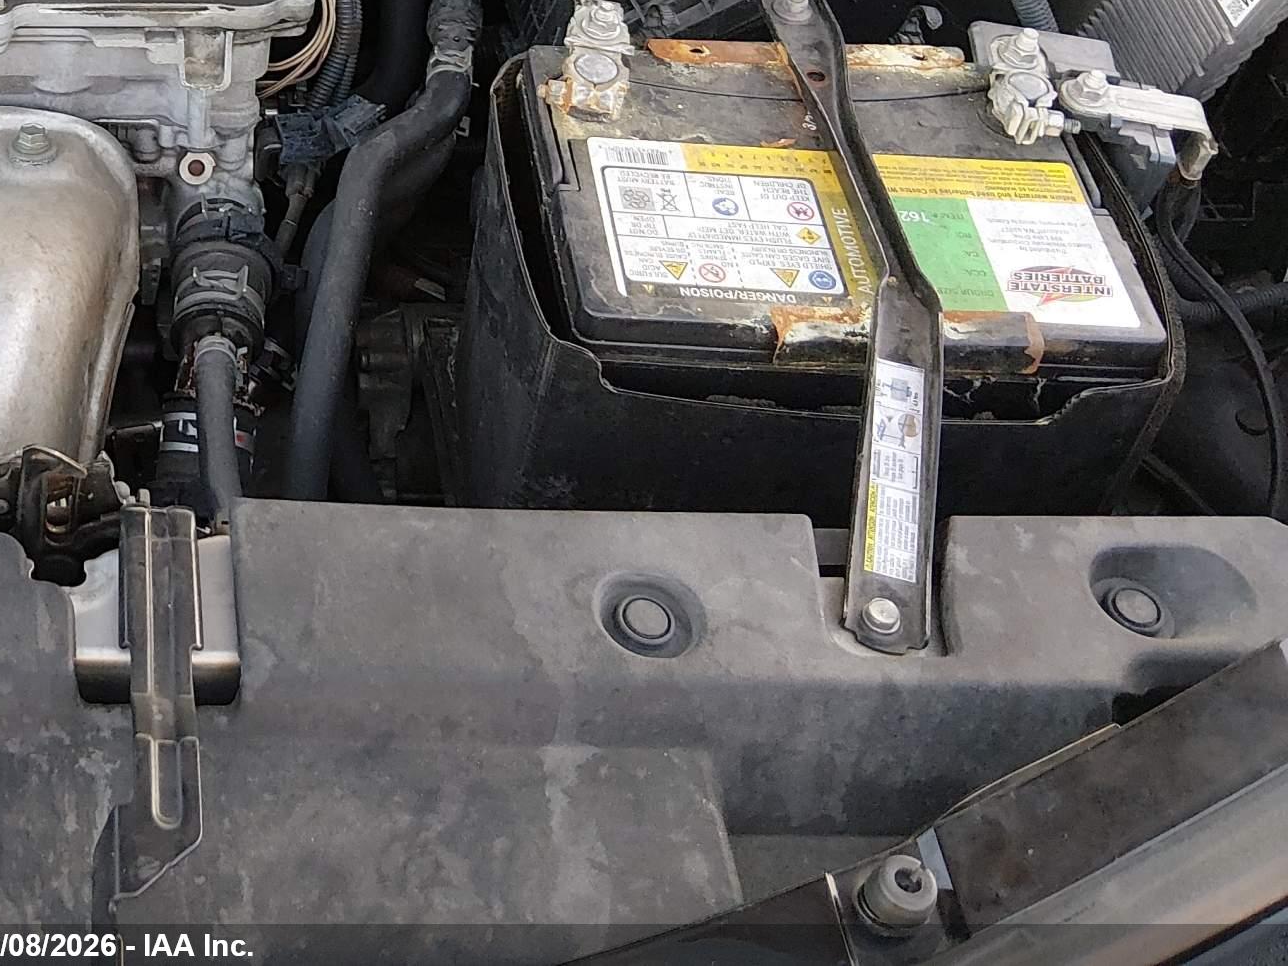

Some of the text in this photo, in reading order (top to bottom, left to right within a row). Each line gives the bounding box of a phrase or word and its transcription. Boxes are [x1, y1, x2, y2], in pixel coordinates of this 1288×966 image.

[753, 180, 793, 188] CHILDREN
[830, 207, 872, 296] AUTOMOTIVE
[1013, 273, 1103, 284] BATTERIES
[679, 287, 797, 303] DANGER/POISON
[1008, 281, 1111, 295] INTERSTATE
